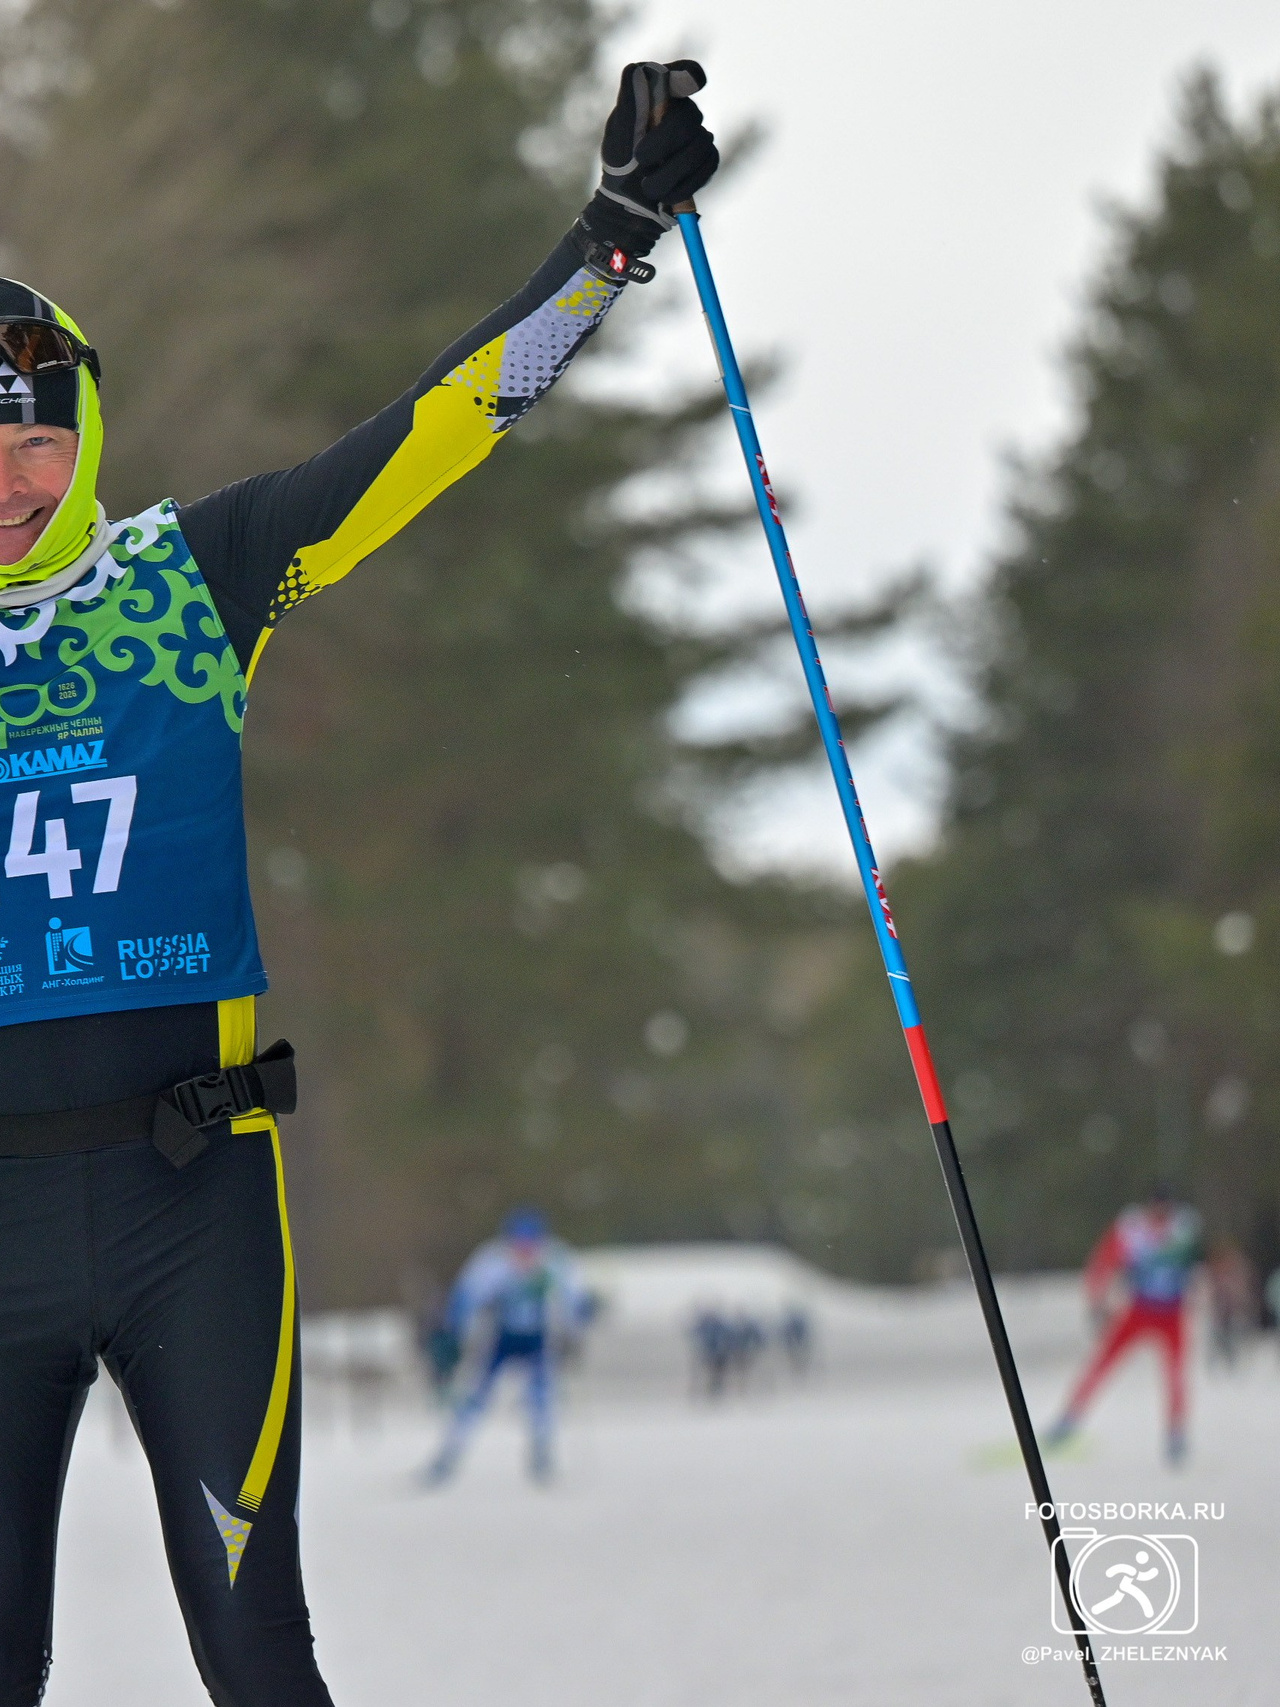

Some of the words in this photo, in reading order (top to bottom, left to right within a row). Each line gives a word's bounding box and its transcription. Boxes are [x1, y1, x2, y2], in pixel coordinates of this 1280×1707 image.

[58, 682, 76, 691] 1626
[58, 690, 78, 700] 2026
[8, 722, 70, 739] НАБЕРЕЖНЫЕ
[70, 716, 102, 728] ЧЕЛНЫ
[57, 731, 69, 741] ЯР
[70, 726, 104, 738] ЧАЛЛЫ
[9, 740, 108, 777] KAMAZ
[117, 932, 210, 960] RUSSIA
[120, 954, 211, 981] LOPPET
[9, 984, 25, 995] РТ
[41, 976, 105, 989] АНГ-Холдинг
